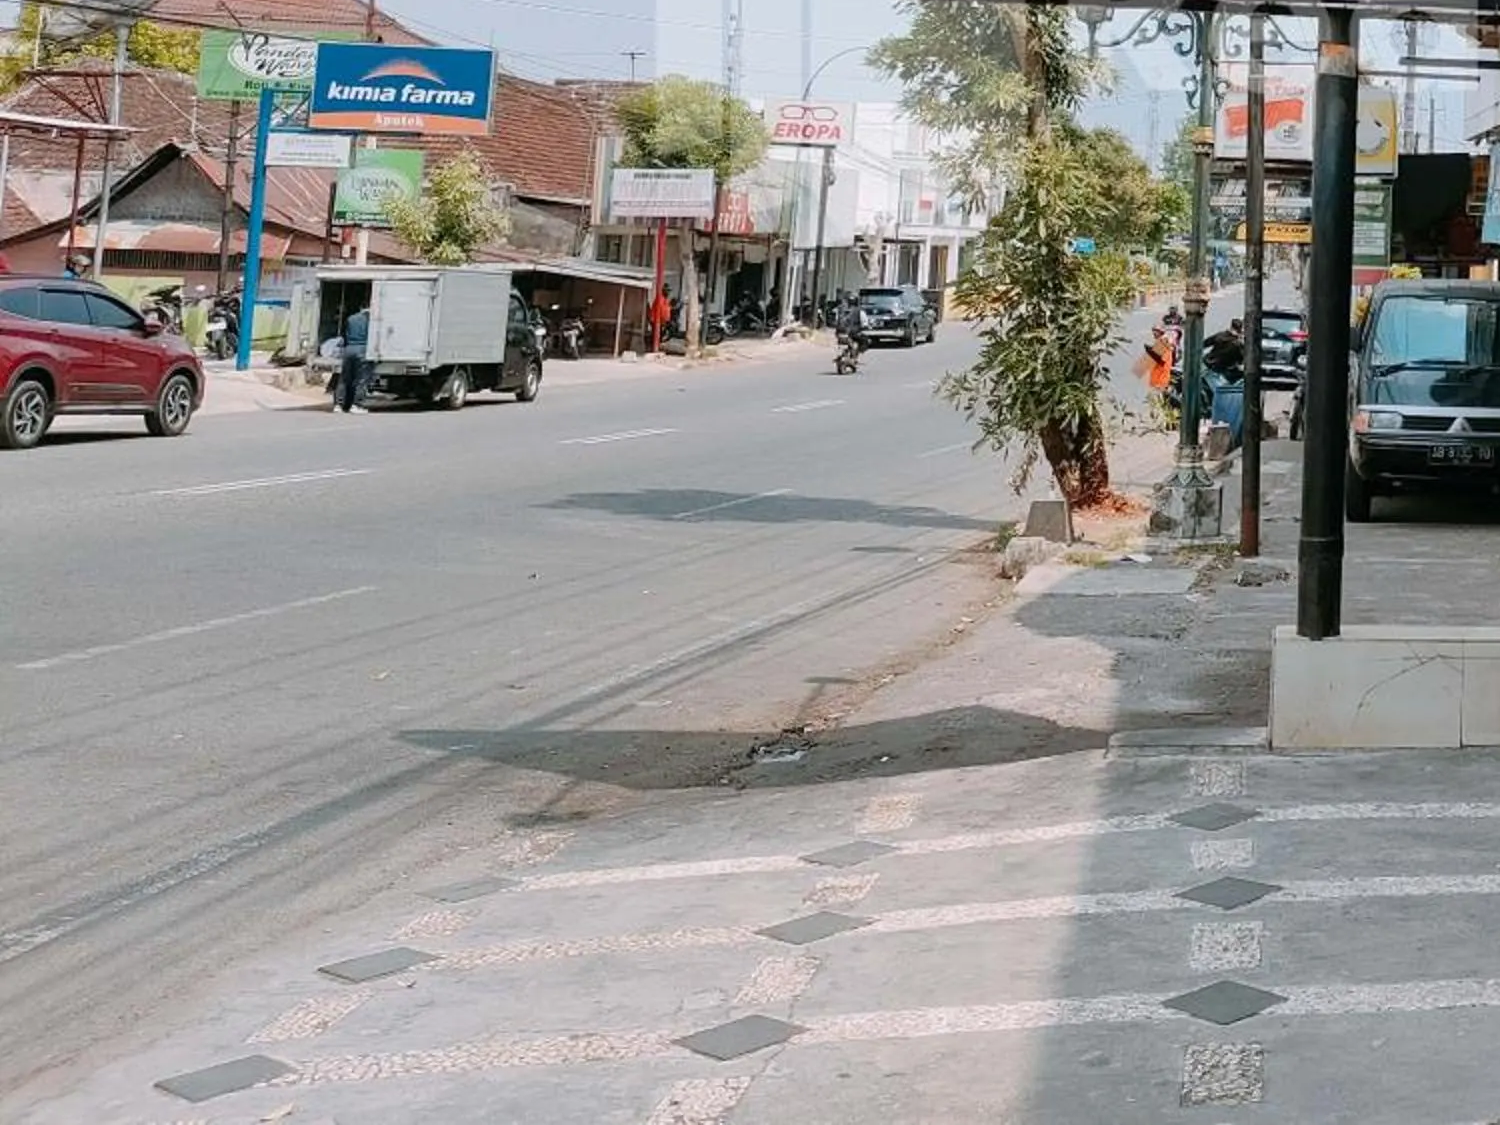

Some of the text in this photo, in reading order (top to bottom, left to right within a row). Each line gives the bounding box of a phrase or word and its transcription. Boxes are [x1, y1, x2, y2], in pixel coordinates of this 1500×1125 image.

[327, 81, 476, 106] kimia farma
[374, 112, 424, 127] Apotek
[773, 121, 842, 140] EROPA
